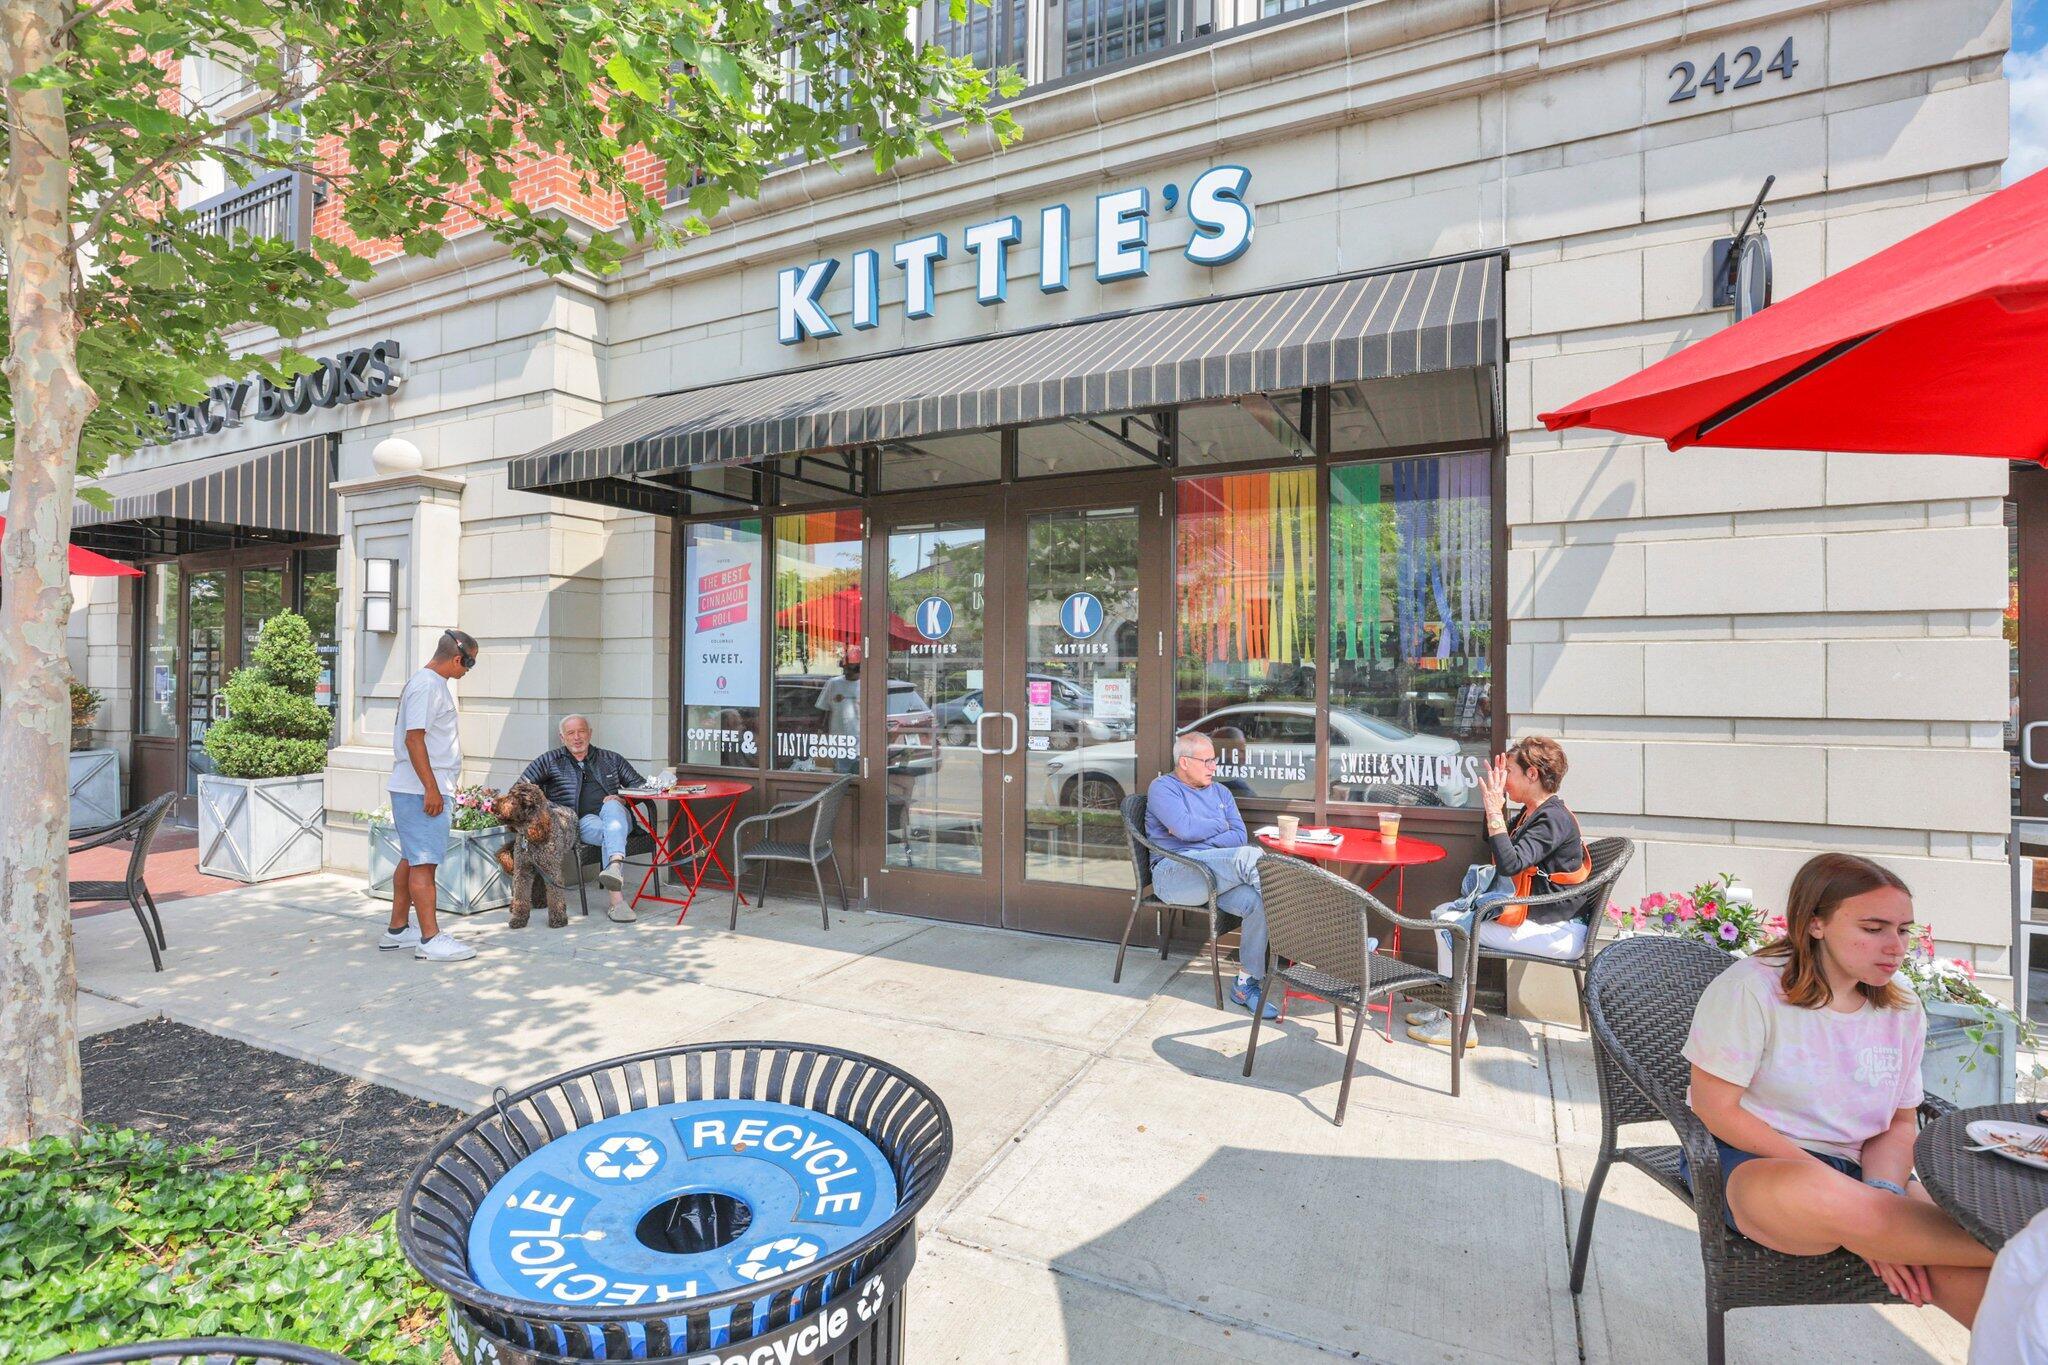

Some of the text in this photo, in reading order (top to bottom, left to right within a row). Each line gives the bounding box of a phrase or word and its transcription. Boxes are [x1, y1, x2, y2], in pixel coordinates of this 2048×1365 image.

[669, 36, 799, 103] 2424
[778, 164, 1254, 345] KITTIE'S
[255, 339, 399, 421] BOOKS
[704, 568, 742, 590] THE BEST
[701, 589, 743, 610] CINNAMON
[713, 612, 731, 627] ROLL
[911, 644, 957, 654] KITTIE'S
[1055, 644, 1109, 654] KITTIE'S
[702, 654, 743, 664] SWEET.
[687, 728, 739, 742] COFFEE
[810, 734, 856, 746] BAKED
[688, 741, 739, 752] ESPRESSO
[777, 733, 808, 757] TASTY
[809, 746, 857, 759] GOODS
[1215, 748, 1305, 767] IGHTFUL
[1212, 765, 1256, 778] KFAST
[1391, 754, 1479, 788] SNACKS
[1340, 775, 1389, 785] SAVORY
[693, 1118, 862, 1217] RECYCLE
